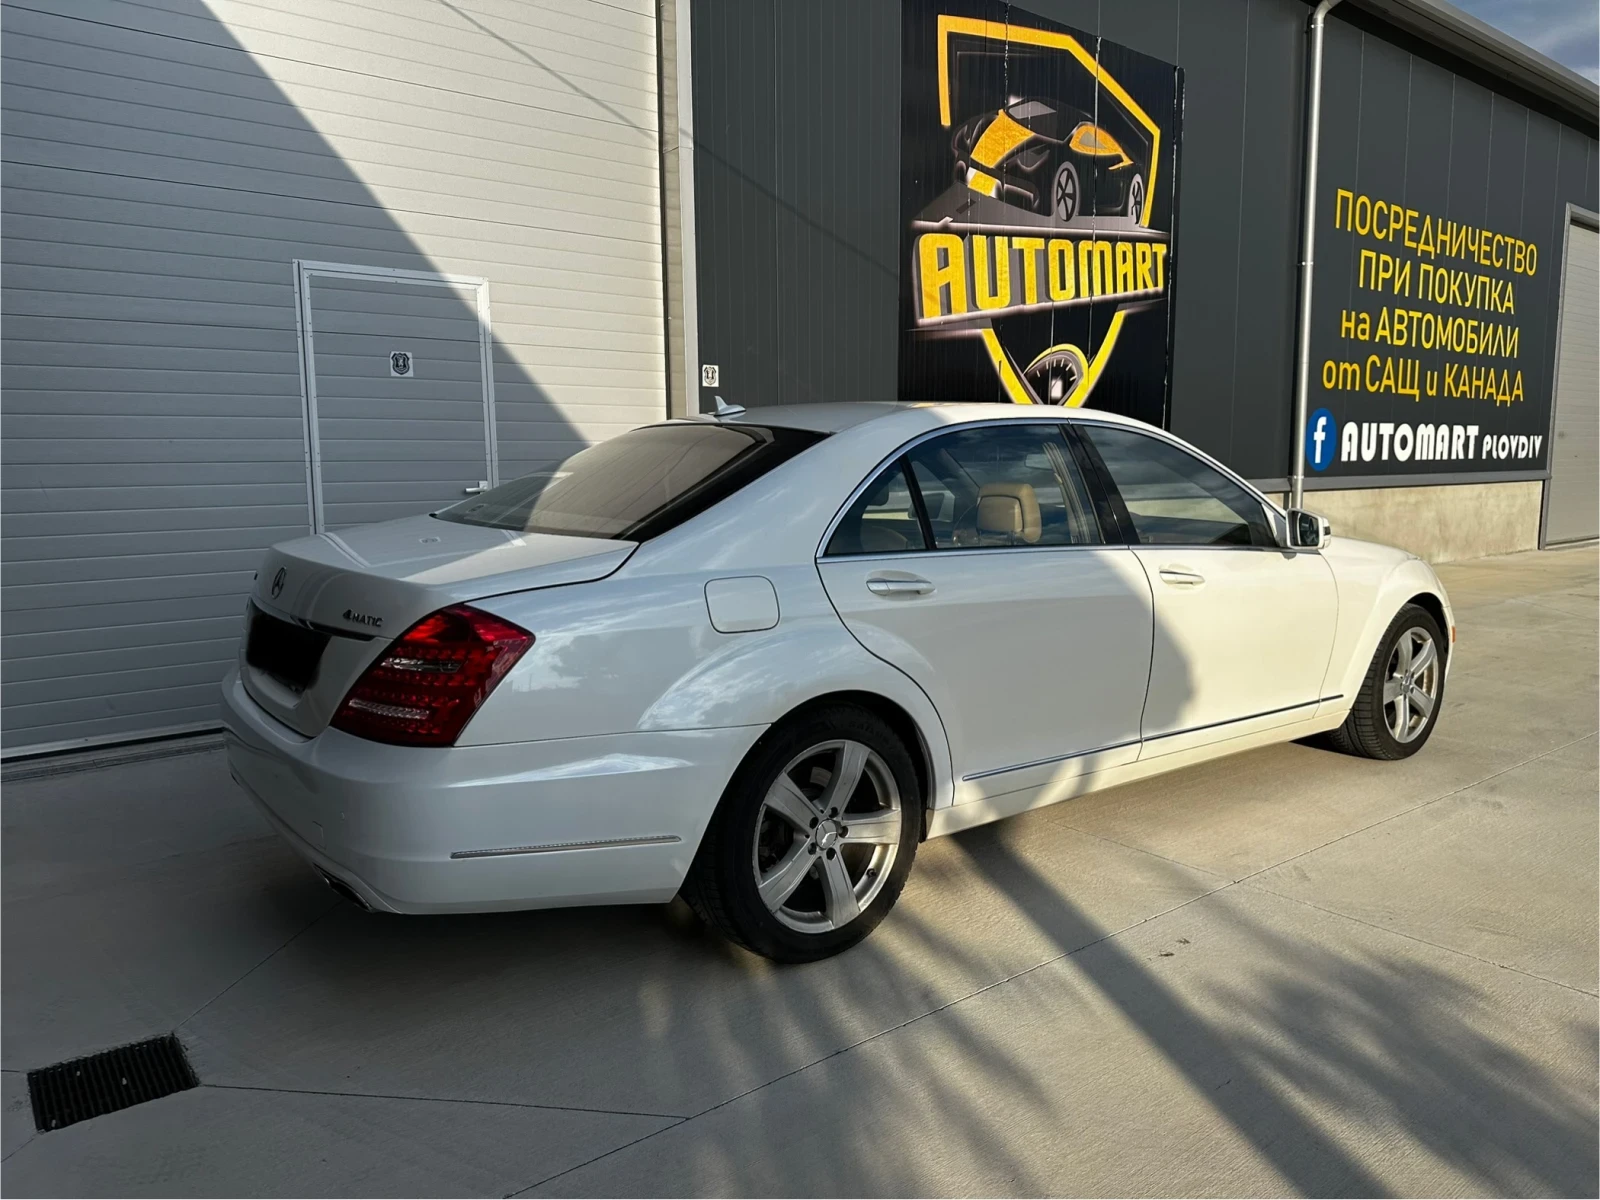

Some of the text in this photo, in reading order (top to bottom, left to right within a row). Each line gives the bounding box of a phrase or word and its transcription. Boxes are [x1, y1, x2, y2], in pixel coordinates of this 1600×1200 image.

[1335, 188, 1538, 276] ПОСРЕДНИЧЕСТВО
[918, 233, 1167, 319] AUTOMART
[1358, 249, 1515, 315] ПРИ ПОКУПКА
[1340, 306, 1520, 359] на АВТОМОБИЛИ
[1322, 354, 1524, 407] от САЩ и КАНАДА
[1340, 421, 1480, 463] AUTOMART
[1481, 434, 1543, 460] PLOVDIV
